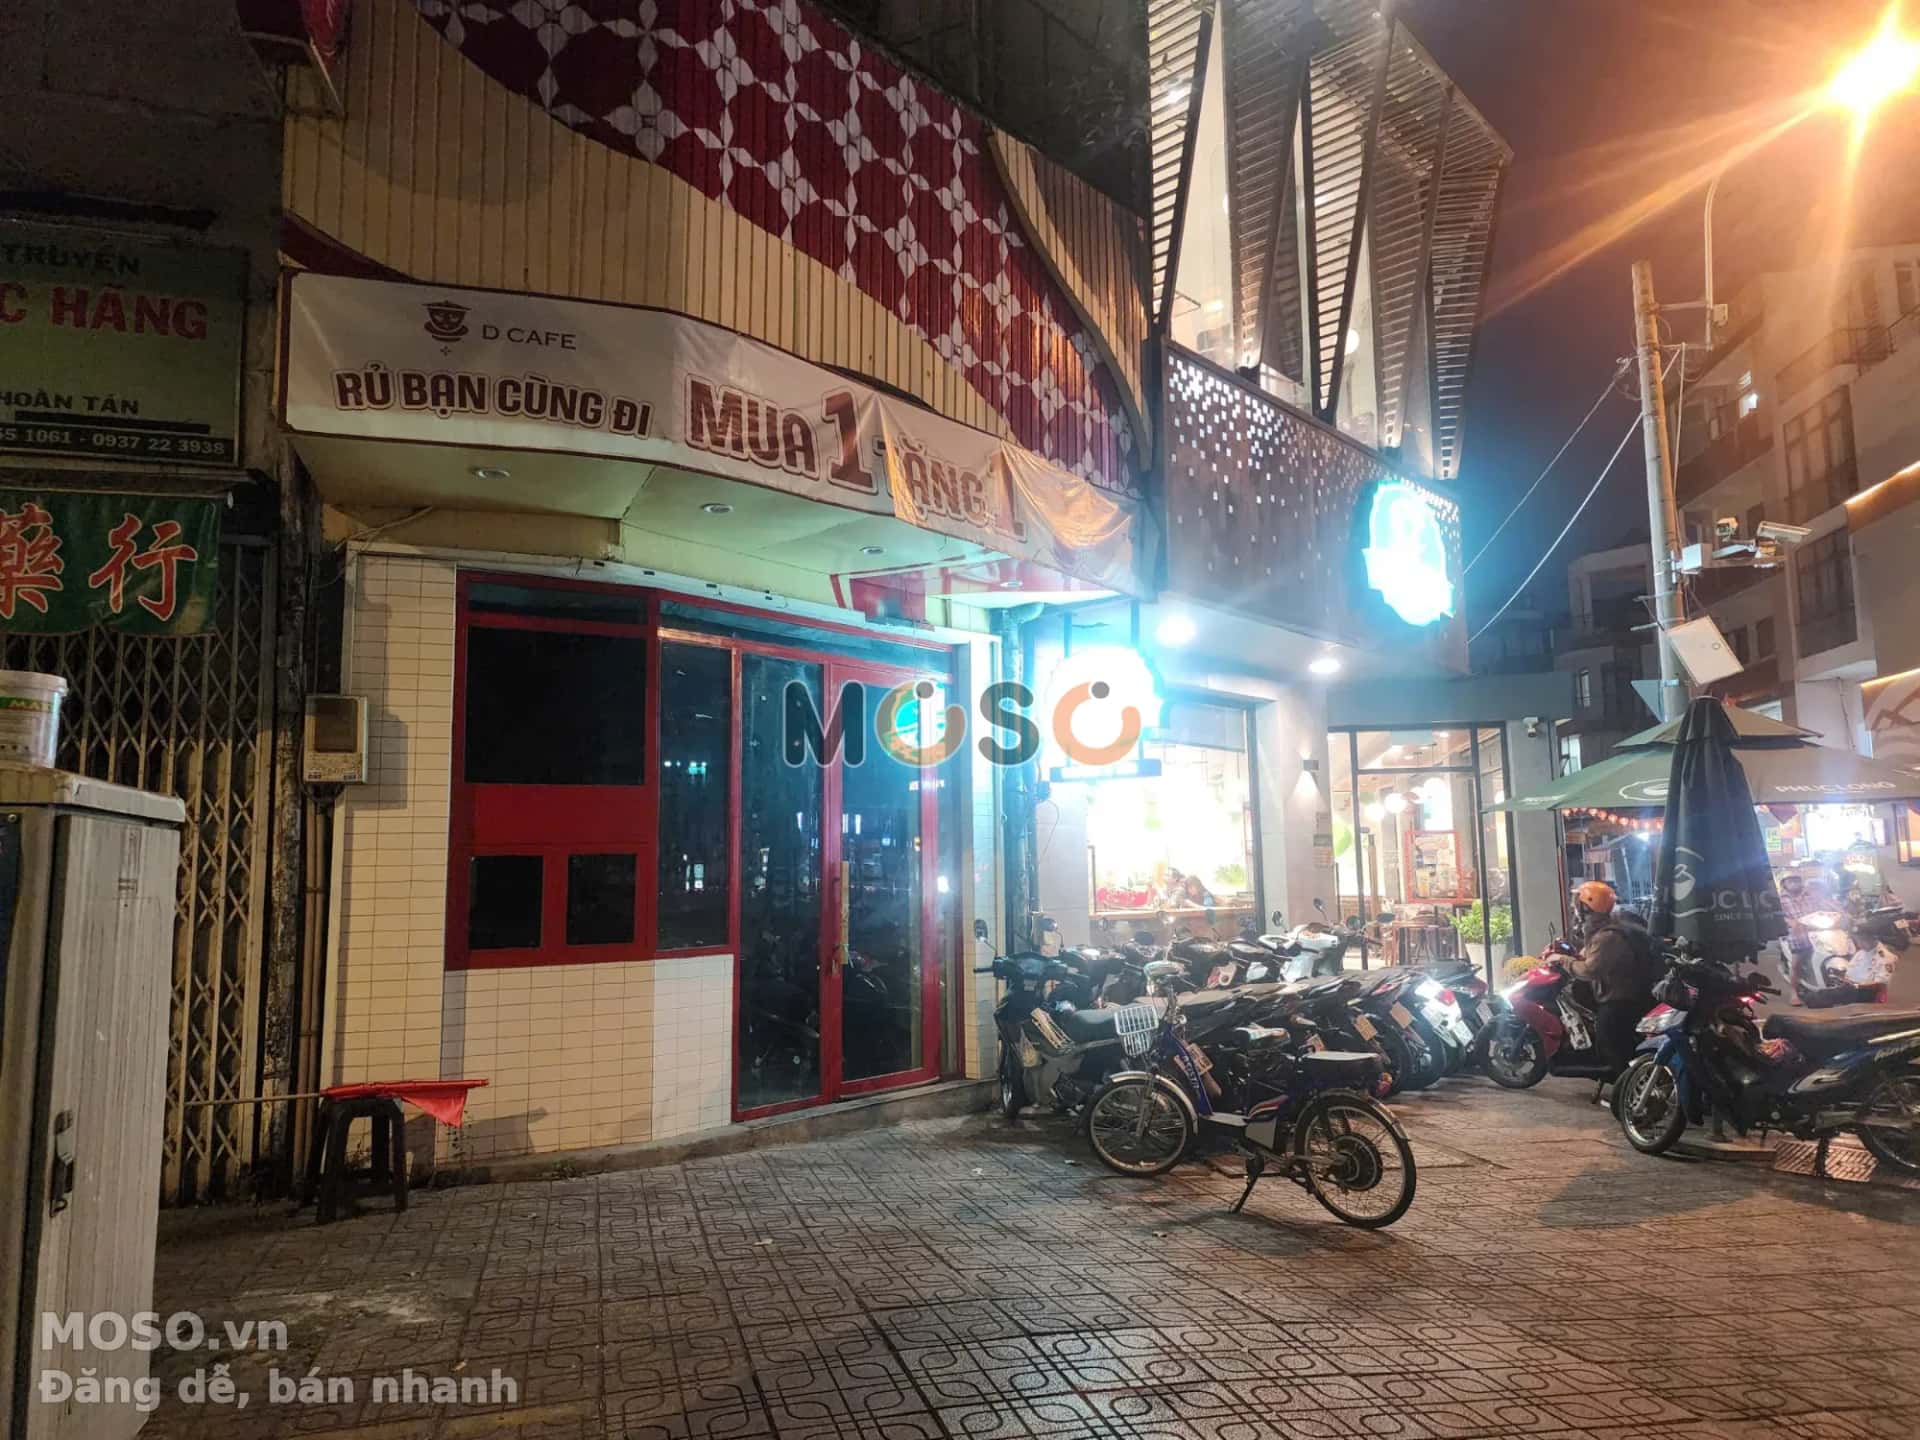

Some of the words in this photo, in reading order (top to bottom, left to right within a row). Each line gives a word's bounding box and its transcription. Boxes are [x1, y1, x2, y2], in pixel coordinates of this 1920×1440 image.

[482, 325, 499, 341] D
[507, 328, 577, 350] CAFE
[335, 363, 390, 408] RỦ
[402, 371, 487, 417] BẠN
[498, 373, 602, 425] CÙNG
[613, 401, 652, 437] ĐI
[24, 428, 73, 444] 1061
[92, 432, 142, 450] 0937
[149, 437, 171, 452] 22
[177, 438, 225, 455] 3938
[689, 380, 816, 478] MUA
[822, 391, 874, 489] 1
